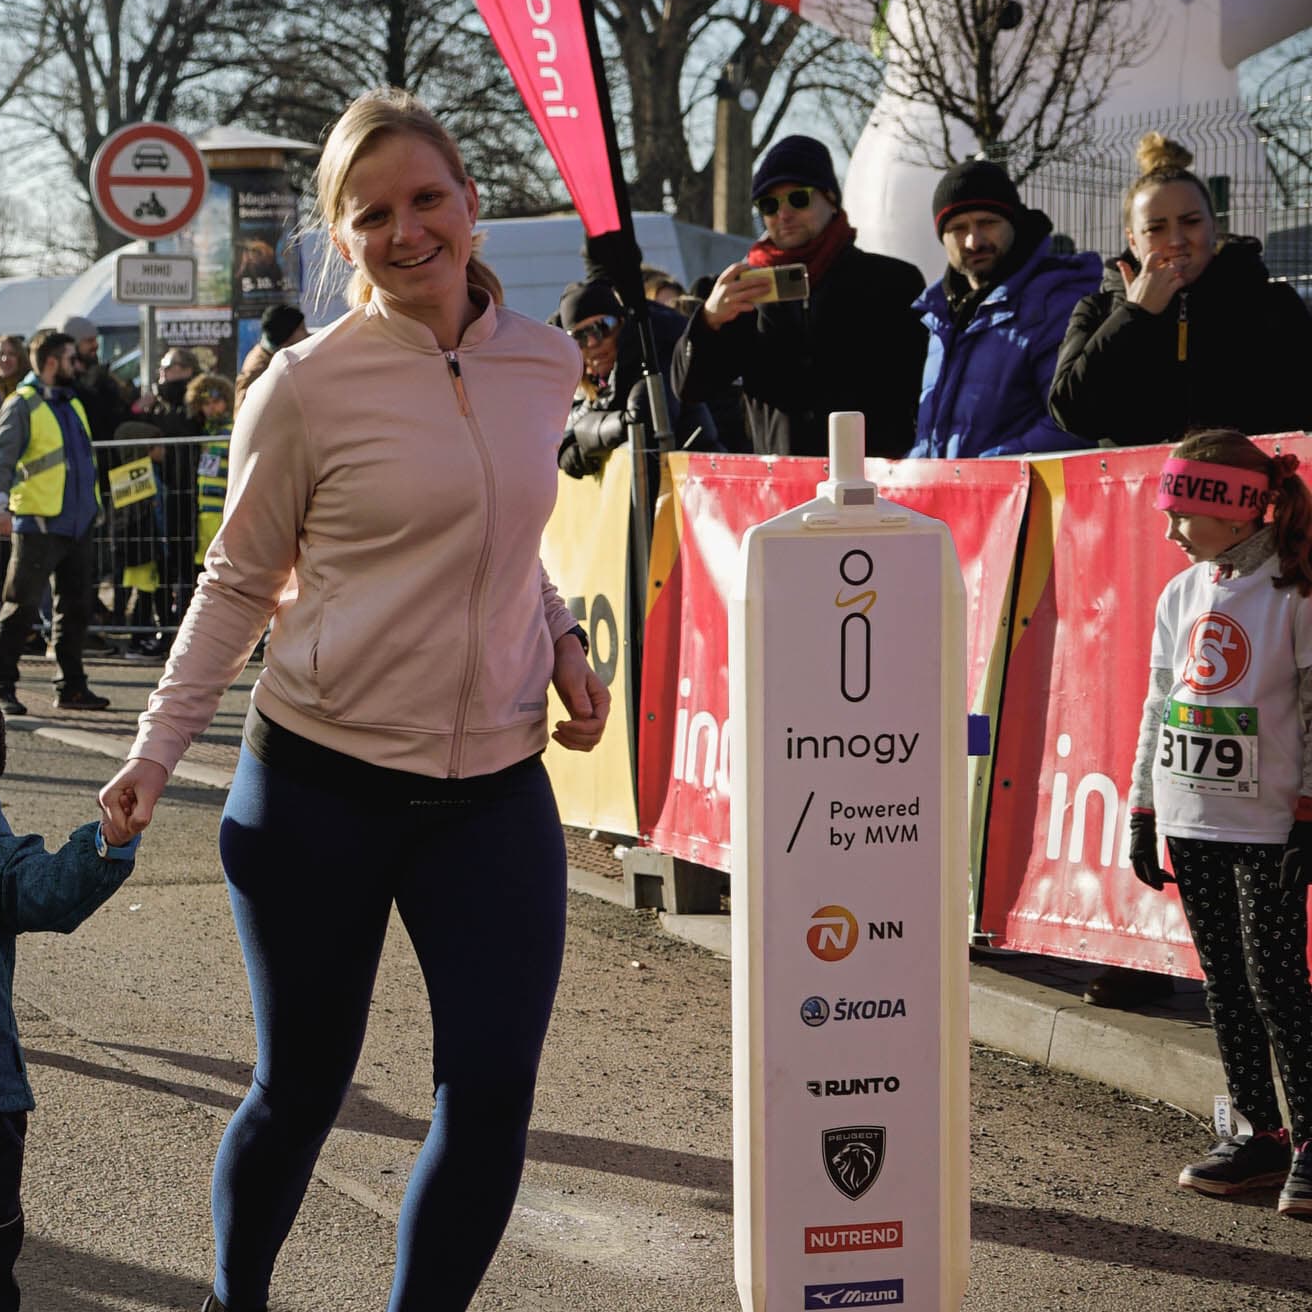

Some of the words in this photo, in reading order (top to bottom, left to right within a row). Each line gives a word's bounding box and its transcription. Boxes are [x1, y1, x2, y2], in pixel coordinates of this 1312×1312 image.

[786, 727, 920, 763] innogy
[1161, 729, 1243, 777] 3179
[830, 798, 920, 821] Powered
[829, 826, 856, 851] by
[865, 824, 919, 845] MVM
[868, 921, 904, 941] NN
[833, 997, 907, 1021] ŠKODA
[825, 1076, 900, 1096] RUNTO
[828, 1132, 880, 1142] PEUGEOT
[809, 1227, 899, 1249] NUTREND
